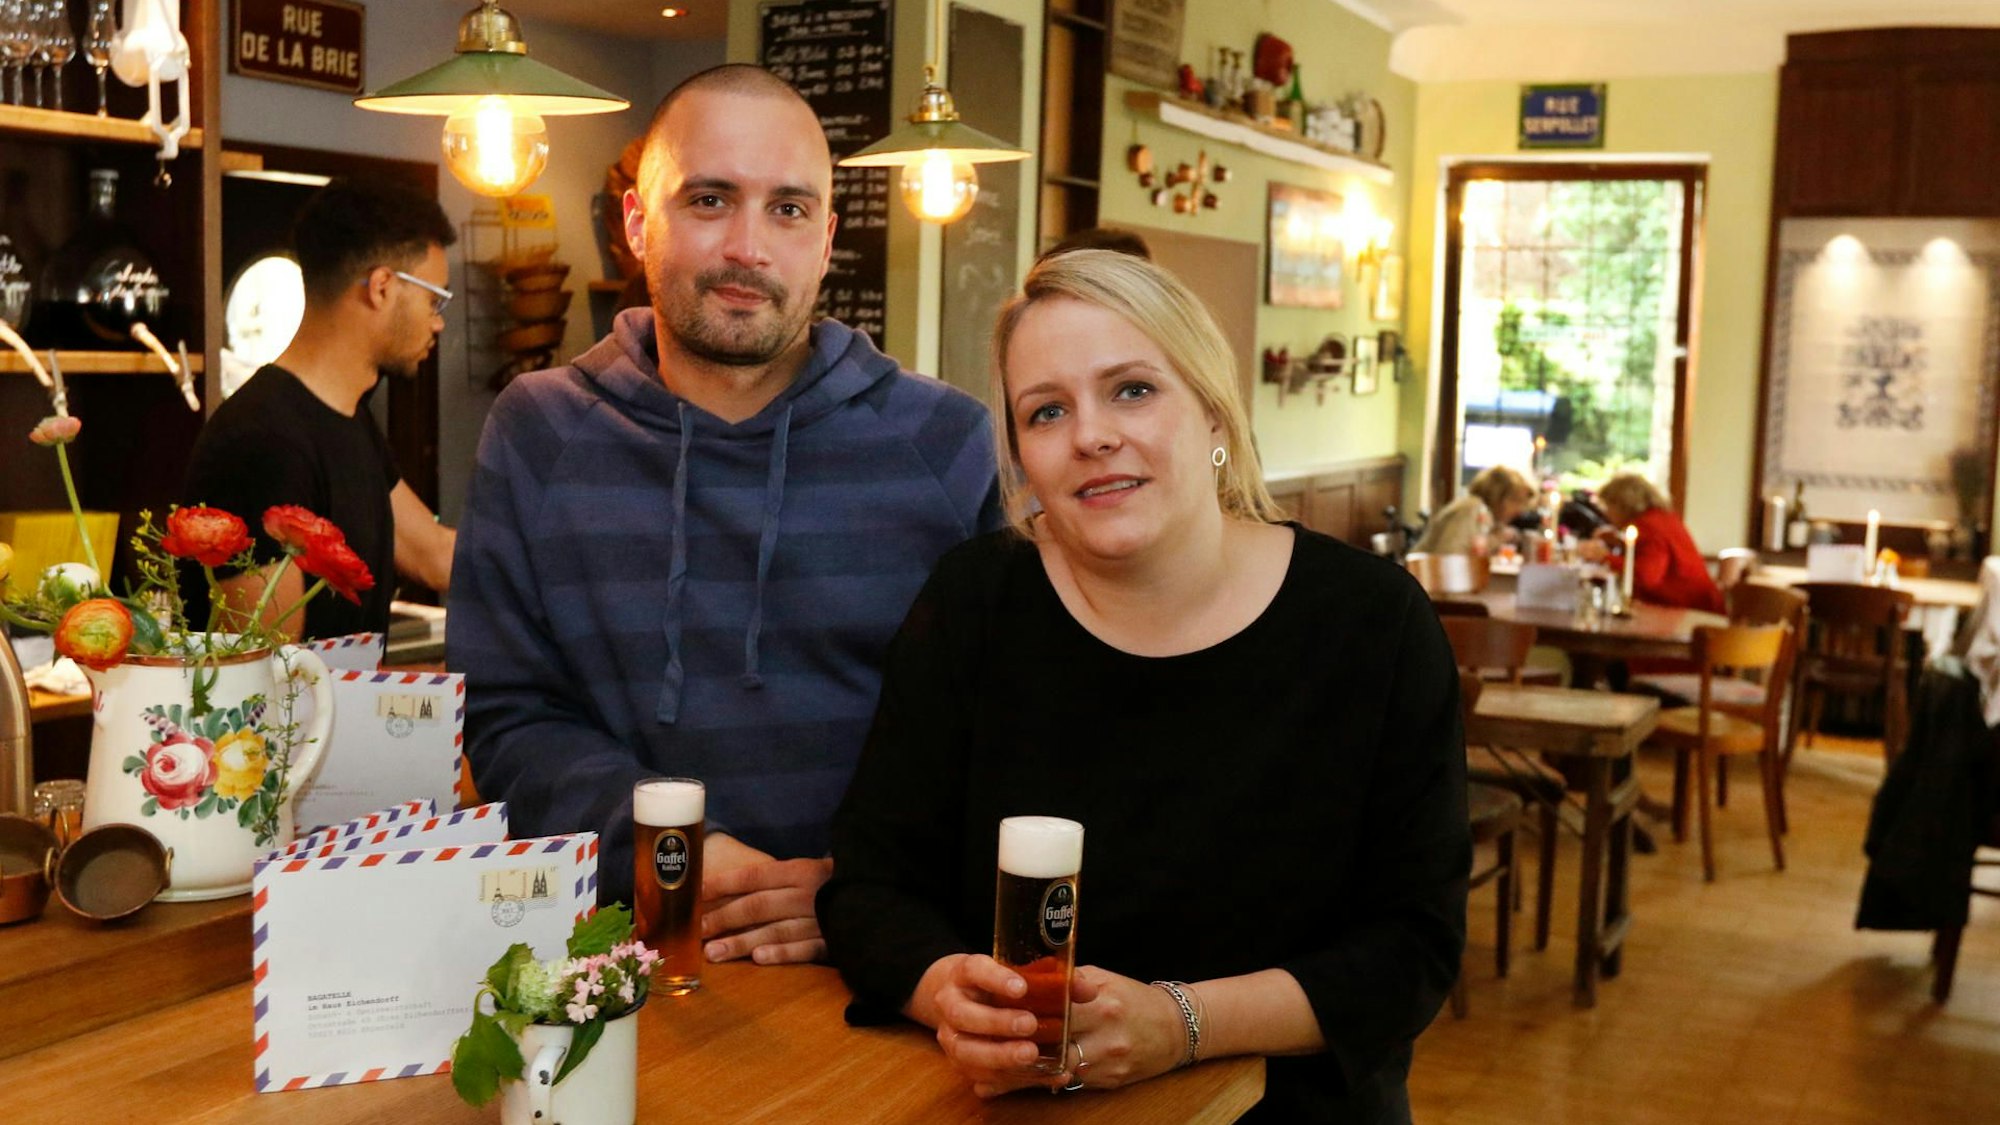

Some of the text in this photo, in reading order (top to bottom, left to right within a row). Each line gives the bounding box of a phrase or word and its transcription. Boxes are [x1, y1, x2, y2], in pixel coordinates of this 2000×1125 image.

[283, 5, 322, 37] RUE
[242, 31, 358, 78] DE LA BRIE
[1544, 96, 1579, 114] RUE
[657, 852, 685, 863] Gaffel
[1045, 904, 1073, 920] Gaffel
